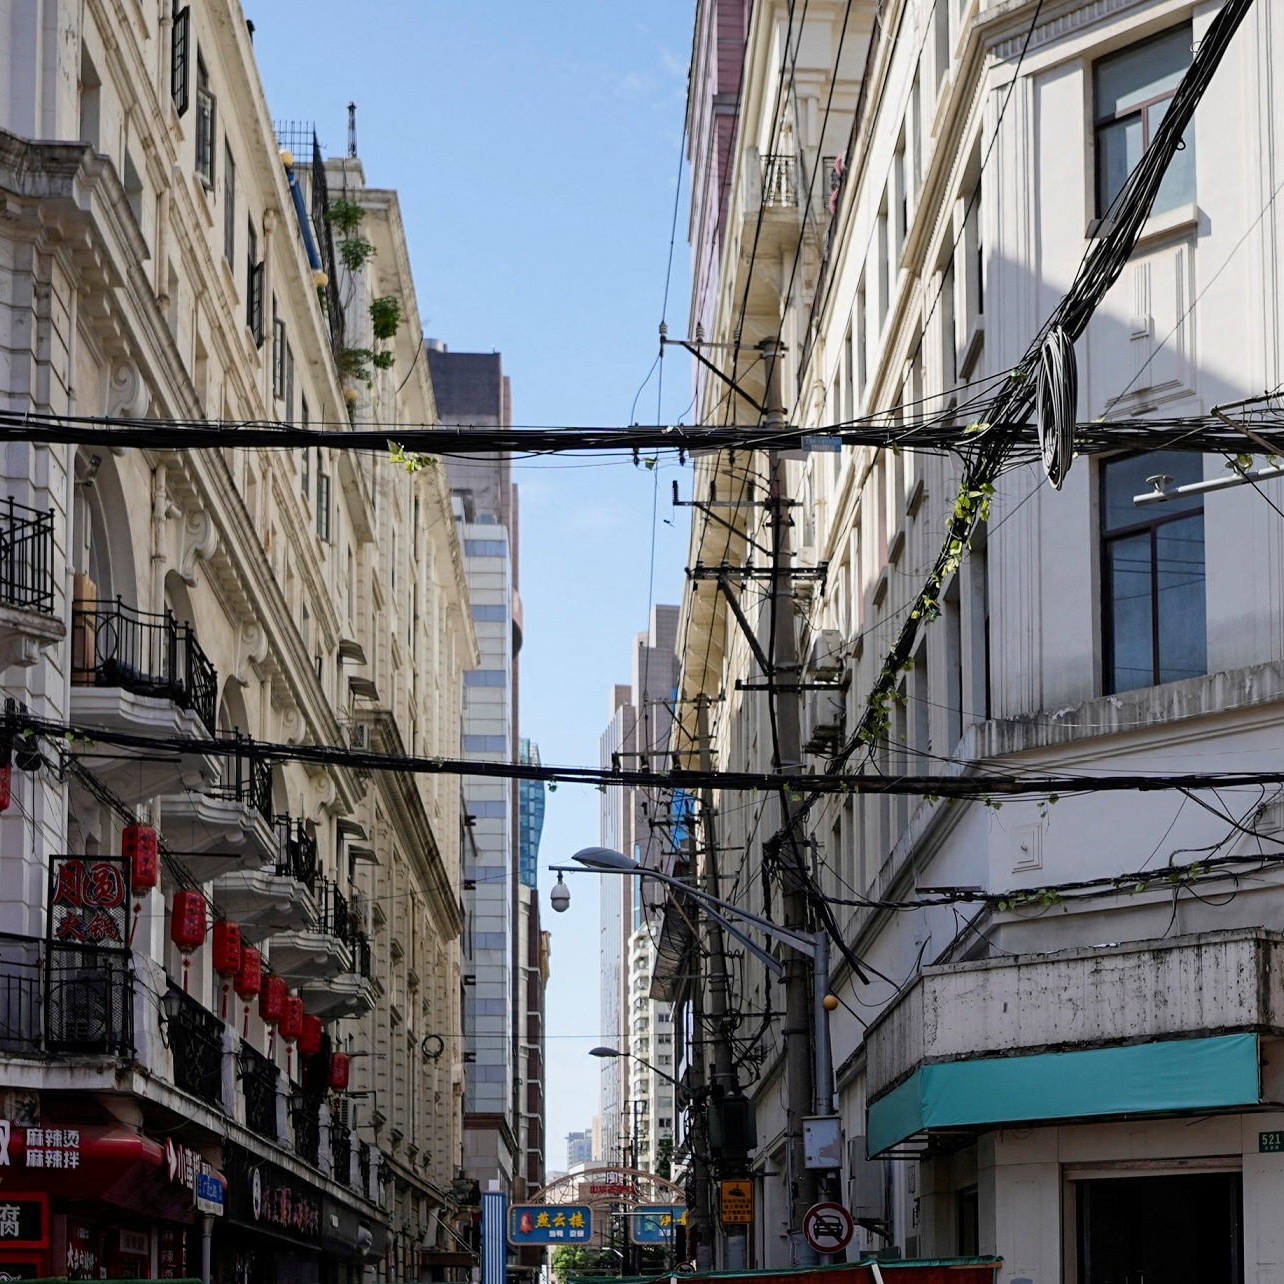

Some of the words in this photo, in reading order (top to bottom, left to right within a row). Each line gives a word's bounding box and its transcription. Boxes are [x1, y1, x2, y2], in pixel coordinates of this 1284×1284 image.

[51, 859, 125, 908] 月圆
[54, 911, 119, 941] 火锅
[26, 1128, 80, 1149] 麻辣烫
[1262, 1133, 1281, 1146] 521
[26, 1149, 80, 1170] 麻辣拌
[534, 1211, 586, 1229] 燕云楼
